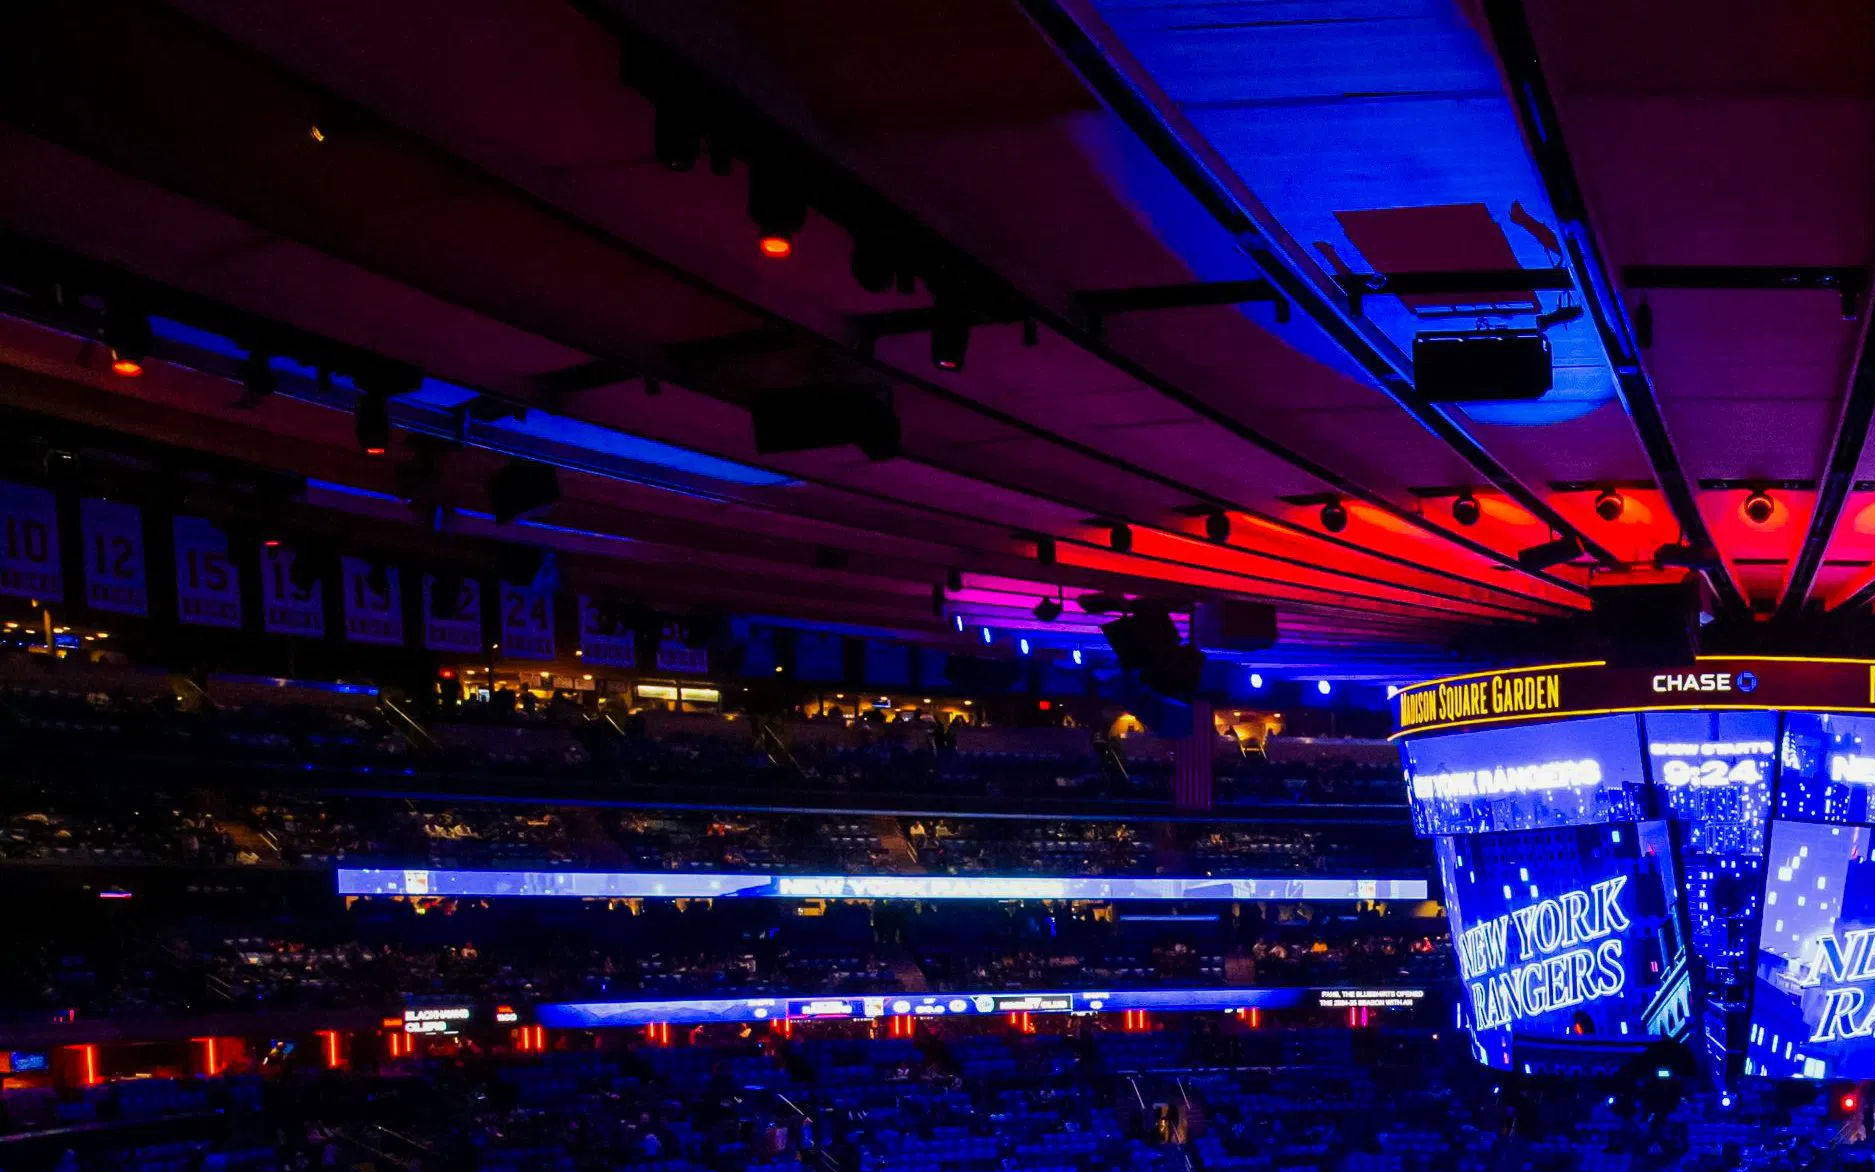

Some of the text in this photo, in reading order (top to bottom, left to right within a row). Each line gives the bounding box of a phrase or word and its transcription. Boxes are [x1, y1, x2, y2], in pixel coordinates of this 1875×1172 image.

[8, 517, 48, 563] 10
[97, 534, 133, 578] 12
[187, 550, 228, 590] 15
[1400, 674, 1560, 727] MADISON SQUARE GARDEN
[1653, 673, 1732, 692] CHASE
[1663, 759, 1764, 787] 9:24
[1458, 875, 1630, 980] NEW YORK
[1472, 939, 1626, 1031] RANGERS
